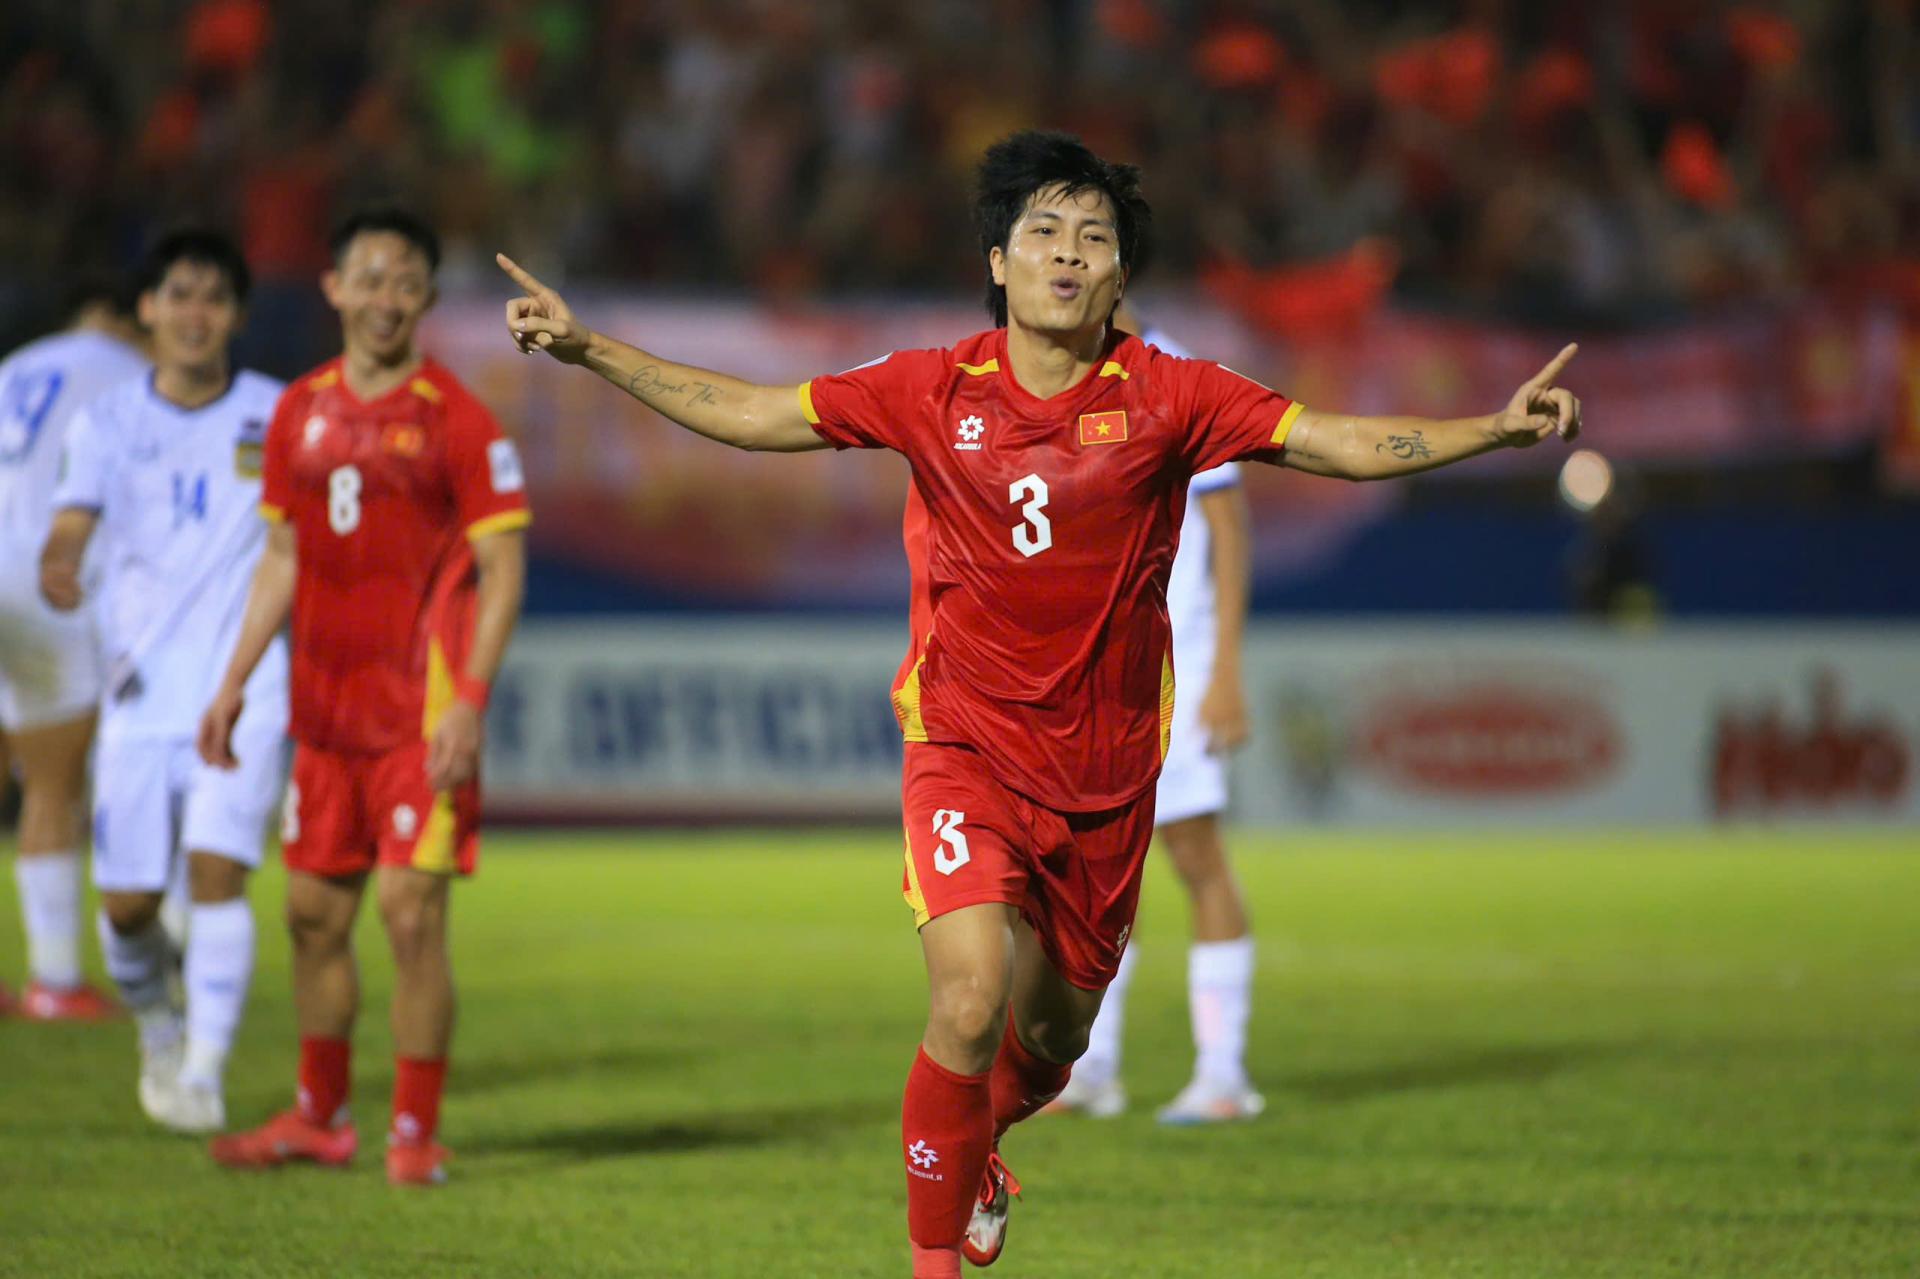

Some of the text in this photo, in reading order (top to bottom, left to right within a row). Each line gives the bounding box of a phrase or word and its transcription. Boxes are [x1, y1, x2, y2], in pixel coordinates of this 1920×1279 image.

[166, 471, 207, 531] 14
[327, 465, 361, 537] 8
[1009, 473, 1053, 558] 3
[931, 807, 971, 876] 3
